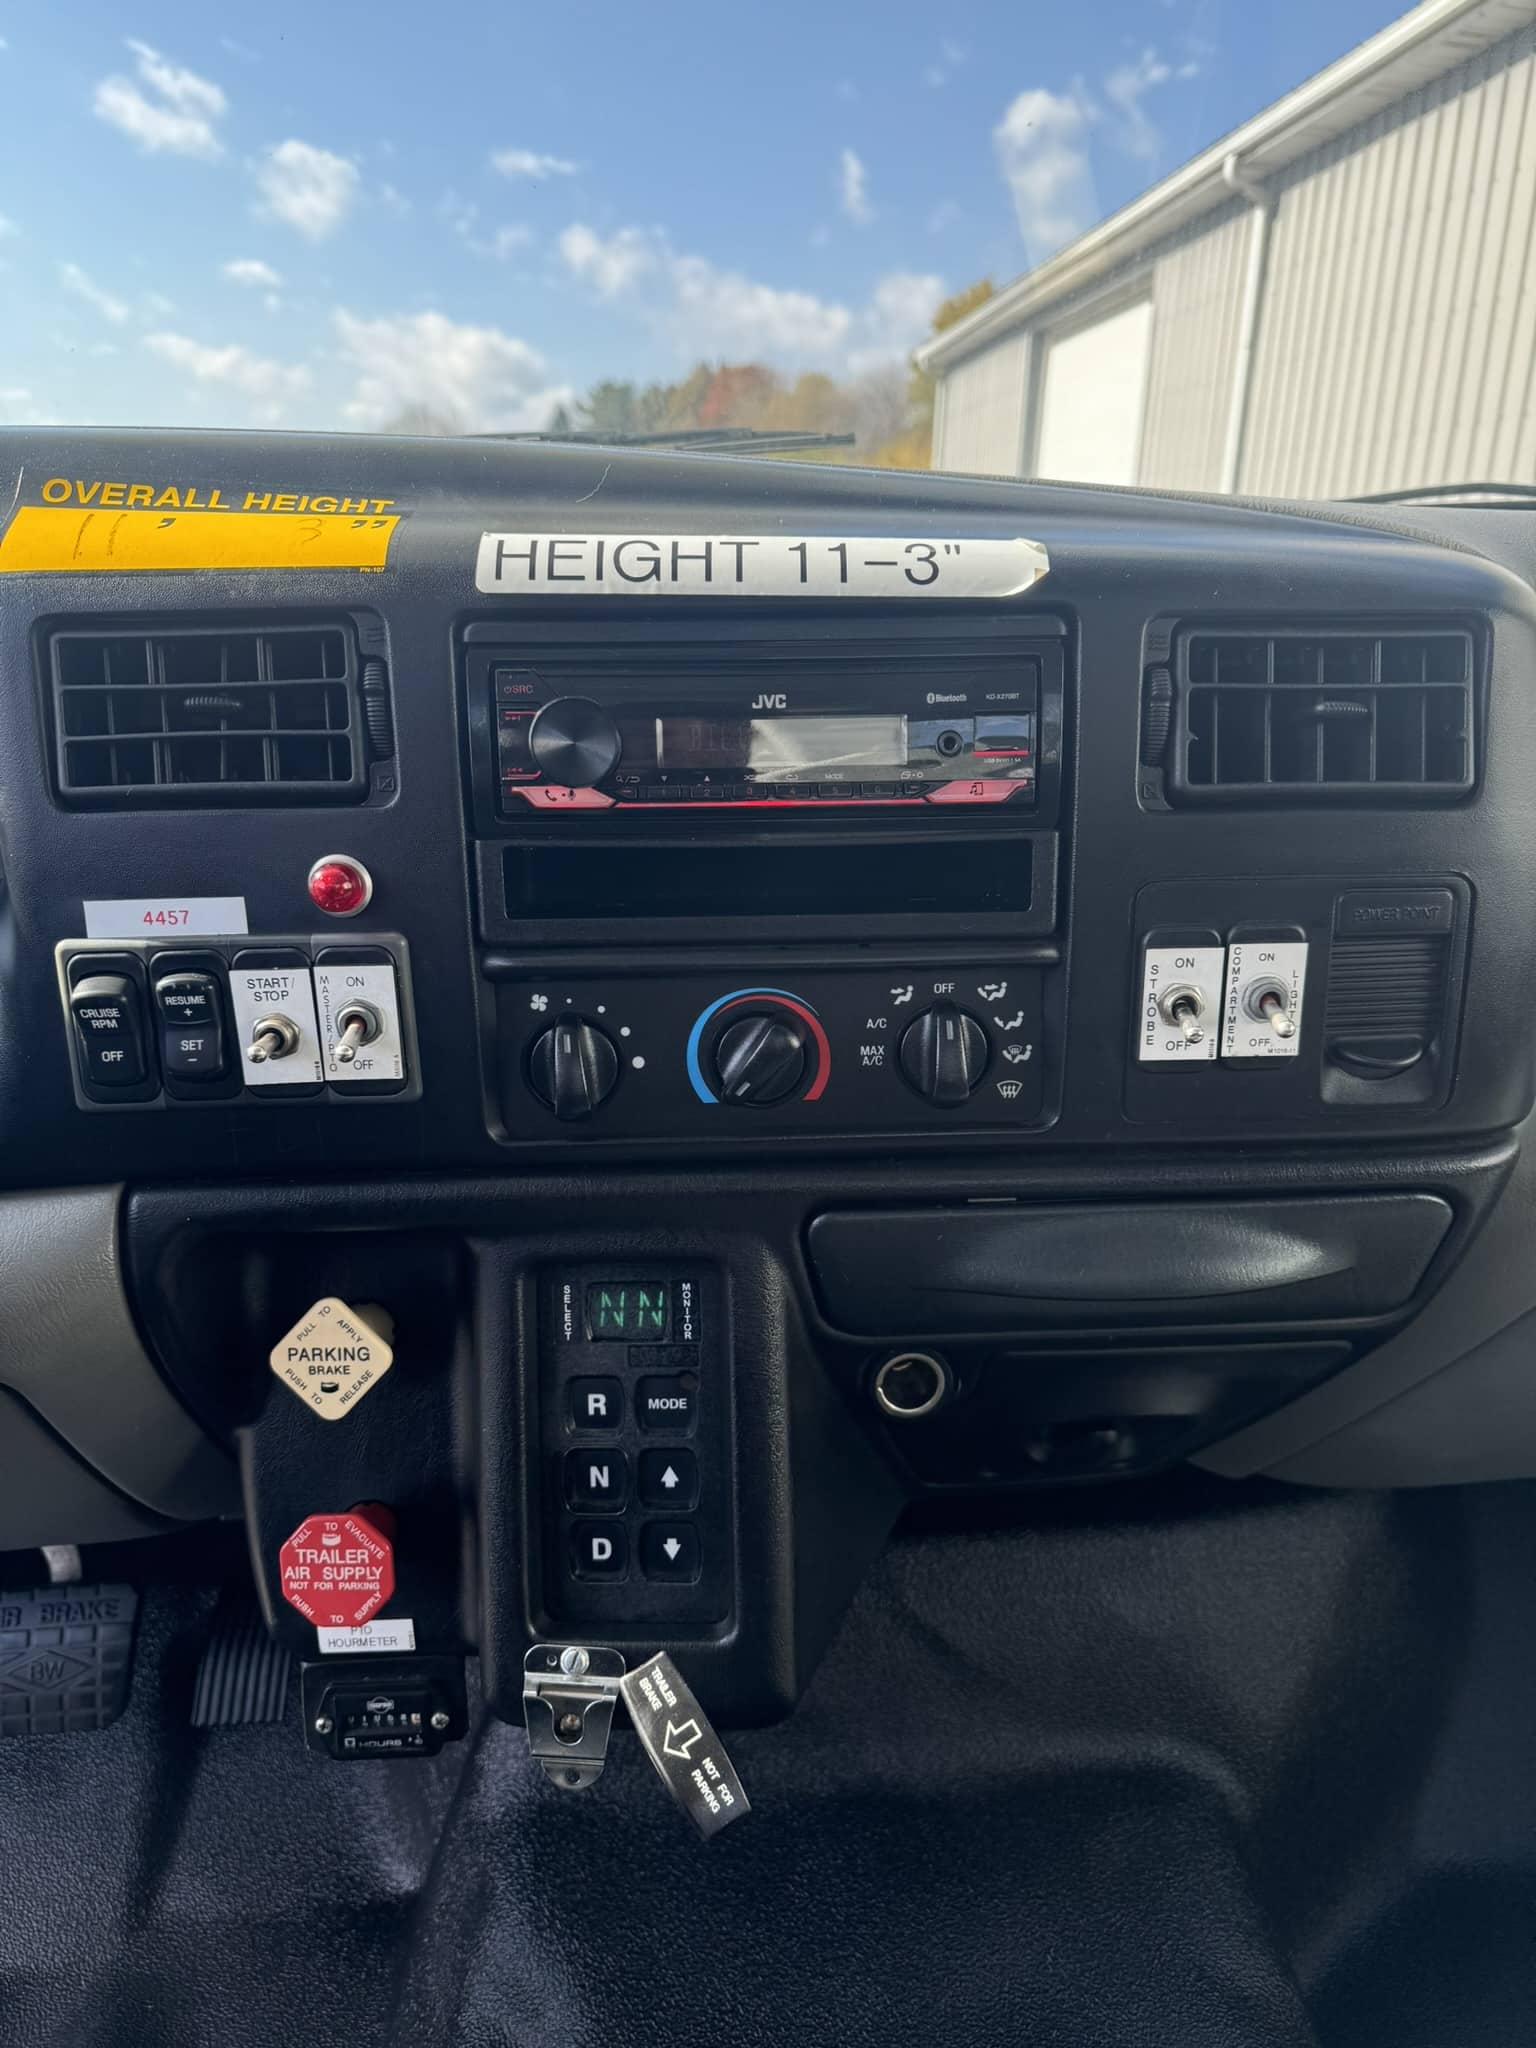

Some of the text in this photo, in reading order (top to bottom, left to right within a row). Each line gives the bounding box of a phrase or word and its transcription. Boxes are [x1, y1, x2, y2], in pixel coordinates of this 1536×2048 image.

[42, 478, 394, 514] OVERALL HEIGHT
[495, 539, 760, 584] HEIGHT
[512, 684, 534, 694] SRC
[752, 694, 787, 709] JVC
[935, 692, 968, 702] Bluetooth
[143, 909, 190, 926] 4457
[1174, 957, 1196, 969] ON
[1258, 952, 1276, 962] ON
[345, 976, 365, 987] ON
[933, 982, 955, 994] OFF
[165, 995, 206, 1006] RESUME
[254, 990, 289, 1002] STOP
[1226, 946, 1243, 1053] COMPARTMENT
[1146, 964, 1160, 1046] STROBE
[79, 1007, 121, 1019] CRUISE
[91, 1019, 118, 1030] RPM
[866, 1018, 887, 1030] A/C
[180, 1039, 204, 1051] SET
[1165, 1040, 1192, 1051] OFF
[1248, 1038, 1271, 1047] OFF
[101, 1050, 124, 1063] OFF
[860, 1046, 885, 1057] MAX
[353, 1059, 374, 1070] OFF
[861, 1055, 883, 1066] A/C
[563, 1284, 572, 1341] SELECT
[681, 1282, 693, 1340] MONITOR
[296, 1304, 364, 1344] PULL TO APPLY
[287, 1346, 371, 1362] PARKING
[308, 1365, 351, 1376] BRAKE
[285, 1367, 374, 1405] PUSH TO RELEASE
[587, 1393, 607, 1416] R
[647, 1398, 688, 1410] MODE
[589, 1466, 610, 1488] N
[291, 1519, 385, 1560] PULL TO EVACUATE
[592, 1538, 612, 1560] D
[295, 1549, 369, 1564] TRAILER
[284, 1566, 383, 1580] AIR SUPPLY
[289, 1581, 380, 1591] NOT FOR PARKING
[40, 1601, 119, 1622] BRAKE
[291, 1591, 382, 1624] PUSH TO SUPPLY
[327, 1636, 399, 1649] HOURMETER
[651, 1665, 678, 1708] TRAILER
[638, 1676, 662, 1712] BRAKE
[701, 1756, 736, 1807] NOT FOR
[690, 1768, 721, 1816] PARKING
